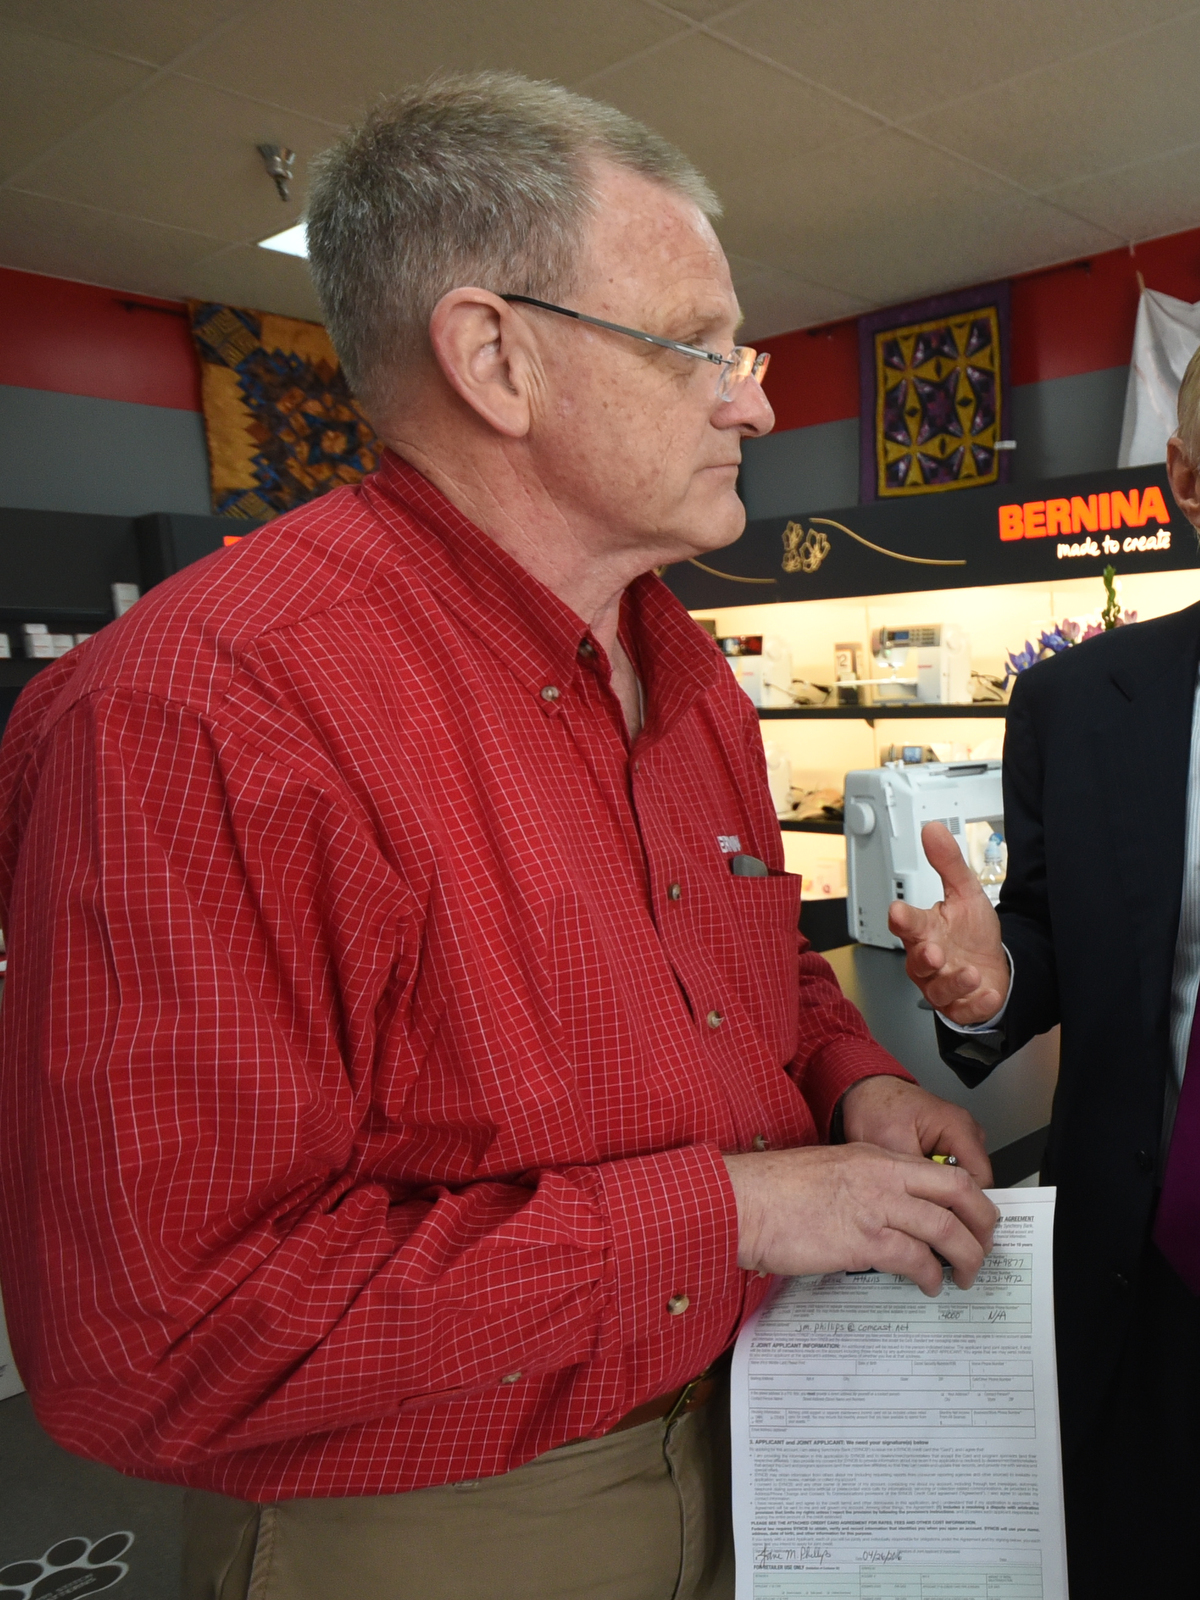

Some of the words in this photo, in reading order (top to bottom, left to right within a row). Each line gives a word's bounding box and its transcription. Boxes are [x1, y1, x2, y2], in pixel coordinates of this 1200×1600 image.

[998, 486, 1171, 541] BERNINA
[1057, 537, 1101, 559] made
[1102, 534, 1121, 554] to
[1123, 528, 1171, 553] create
[814, 1321, 845, 1335] phillips
[847, 1323, 856, 1332] @
[895, 1323, 909, 1331] net
